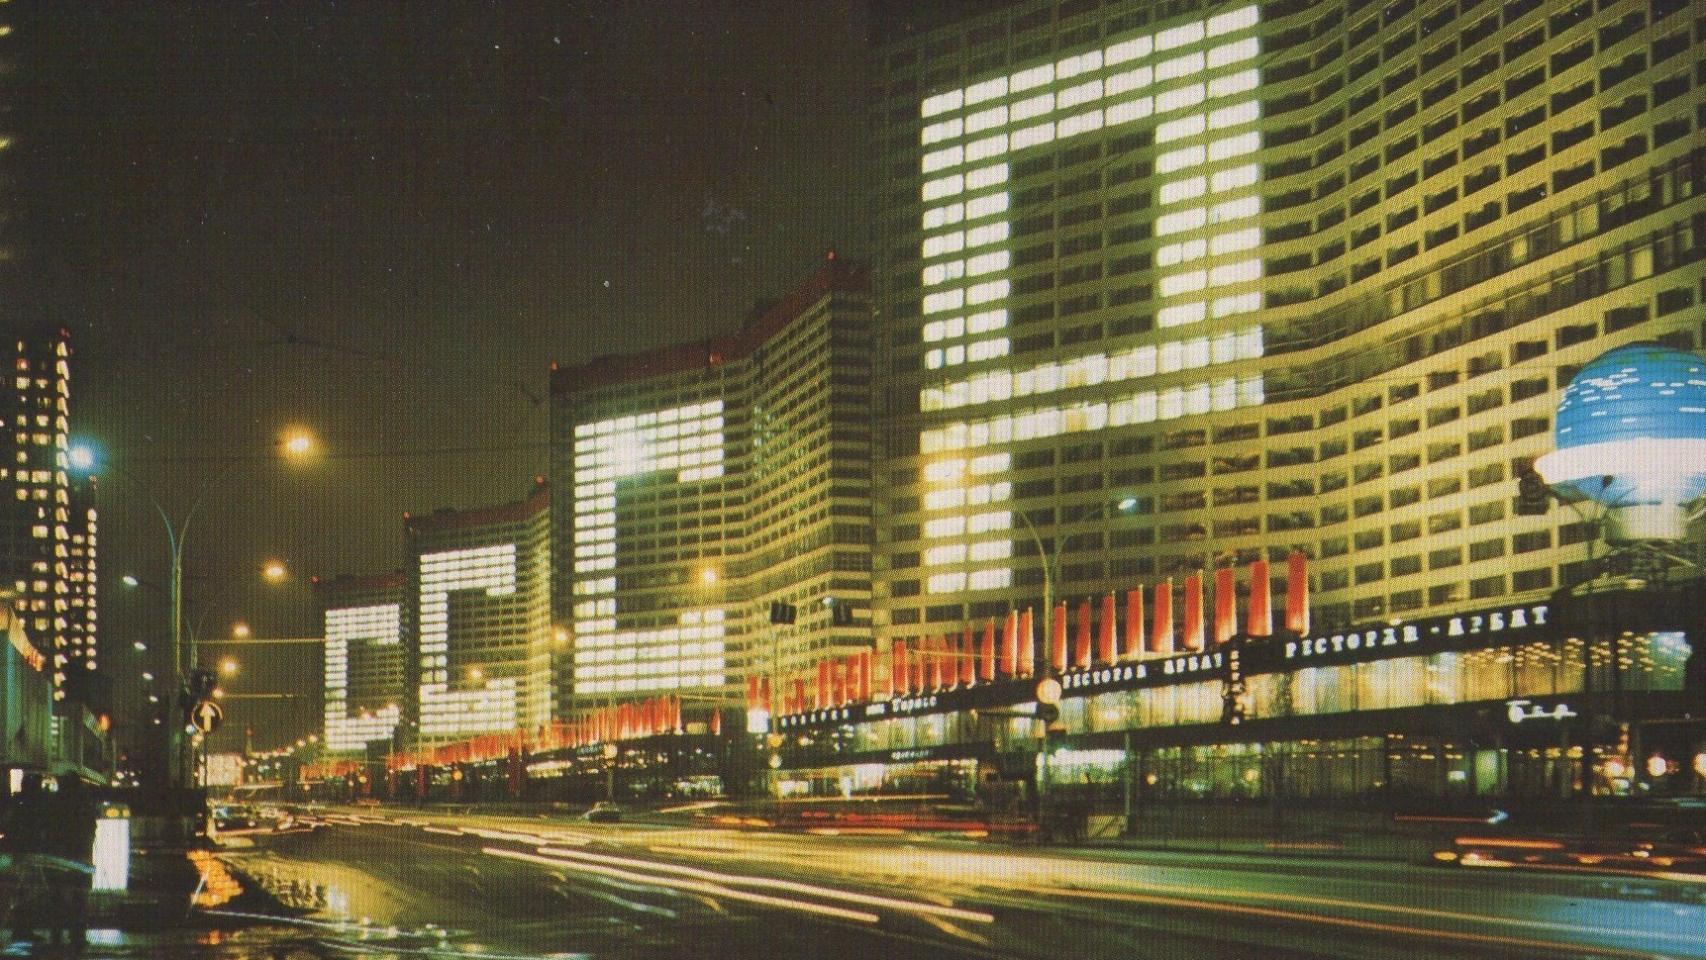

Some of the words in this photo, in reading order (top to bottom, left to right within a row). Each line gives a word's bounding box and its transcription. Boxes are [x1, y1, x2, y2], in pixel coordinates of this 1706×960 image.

[1286, 625, 1419, 658] РЕСТОРАН
[1447, 605, 1549, 637] АРБАТ
[1062, 664, 1147, 690] РЕСТОРАН
[1164, 653, 1222, 675] АРБАТ
